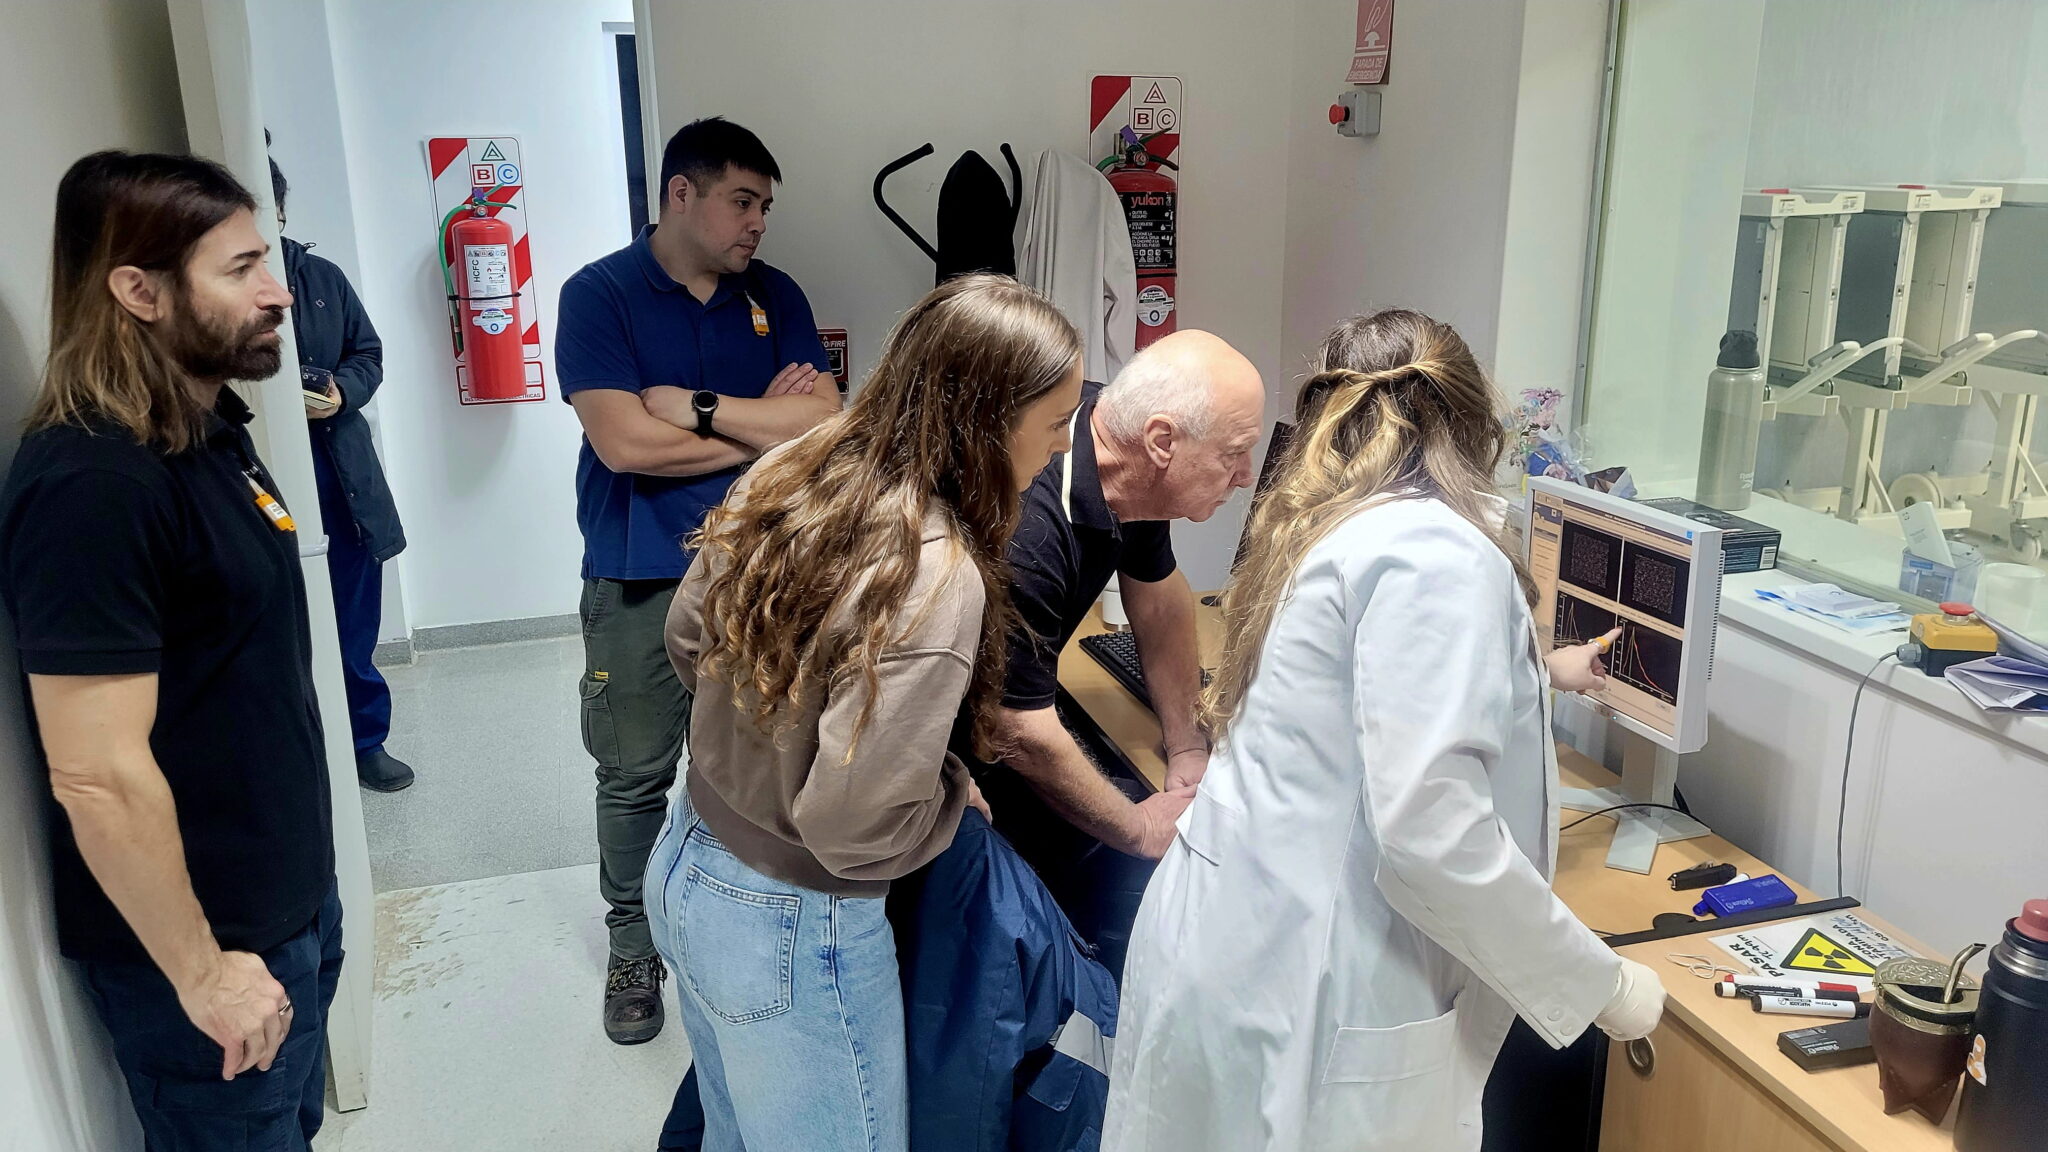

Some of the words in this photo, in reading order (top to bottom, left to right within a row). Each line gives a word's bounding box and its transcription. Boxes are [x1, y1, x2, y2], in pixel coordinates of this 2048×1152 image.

[1150, 90, 1161, 100] A
[1137, 113, 1149, 125] B
[1161, 113, 1171, 125] C
[487, 148, 500, 158] A
[477, 169, 491, 180] B
[503, 168, 514, 179] C
[1131, 194, 1164, 208] yukon
[471, 259, 481, 283] HCFC
[830, 340, 846, 348] FIRE
[1832, 924, 1891, 960] NTAMINADA
[1848, 940, 1880, 959] ZONA
[1729, 943, 1785, 977] PASAR
